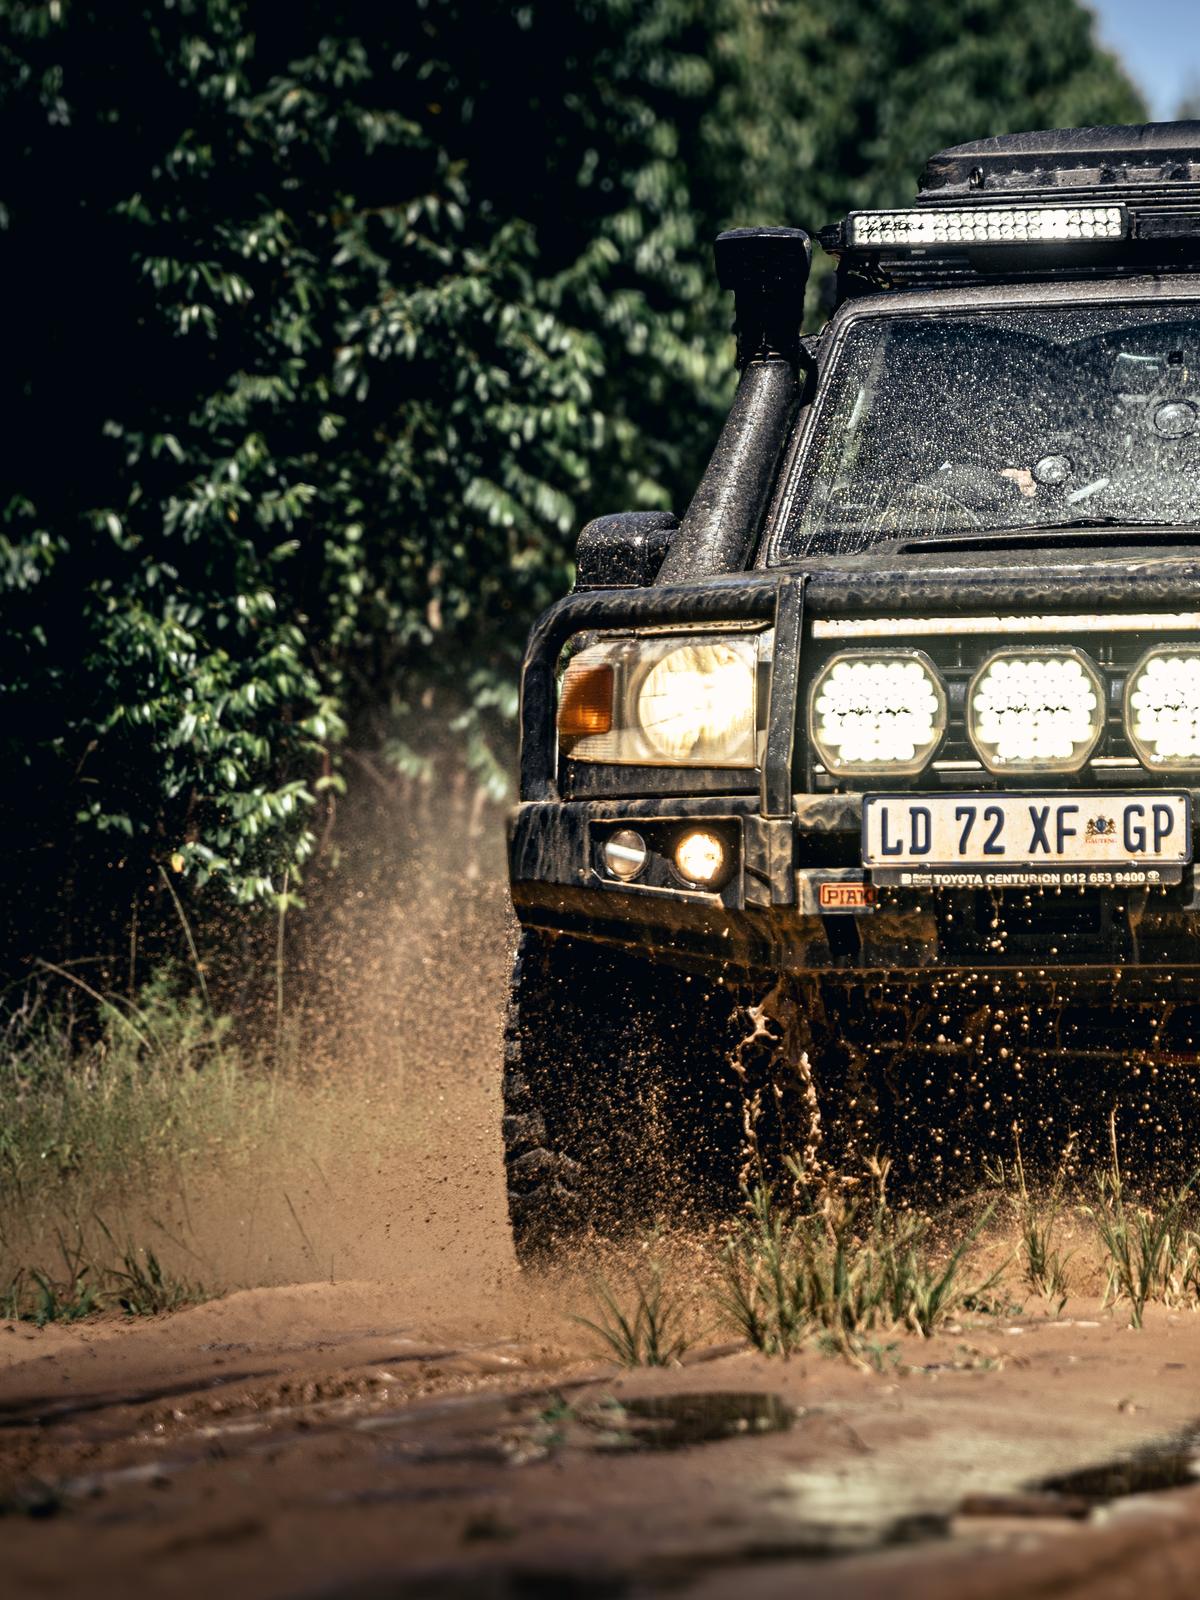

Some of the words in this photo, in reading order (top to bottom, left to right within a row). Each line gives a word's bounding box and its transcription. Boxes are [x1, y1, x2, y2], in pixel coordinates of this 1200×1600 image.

[881, 806, 932, 855] LD
[955, 805, 1005, 855] 72
[1028, 805, 1079, 854] XF
[1122, 804, 1175, 853] GP
[933, 873, 983, 884] TOYOTA
[985, 873, 1061, 884] CENTURION
[1063, 873, 1086, 883] 012
[1089, 872, 1112, 883] 653
[1115, 871, 1146, 883] 9400
